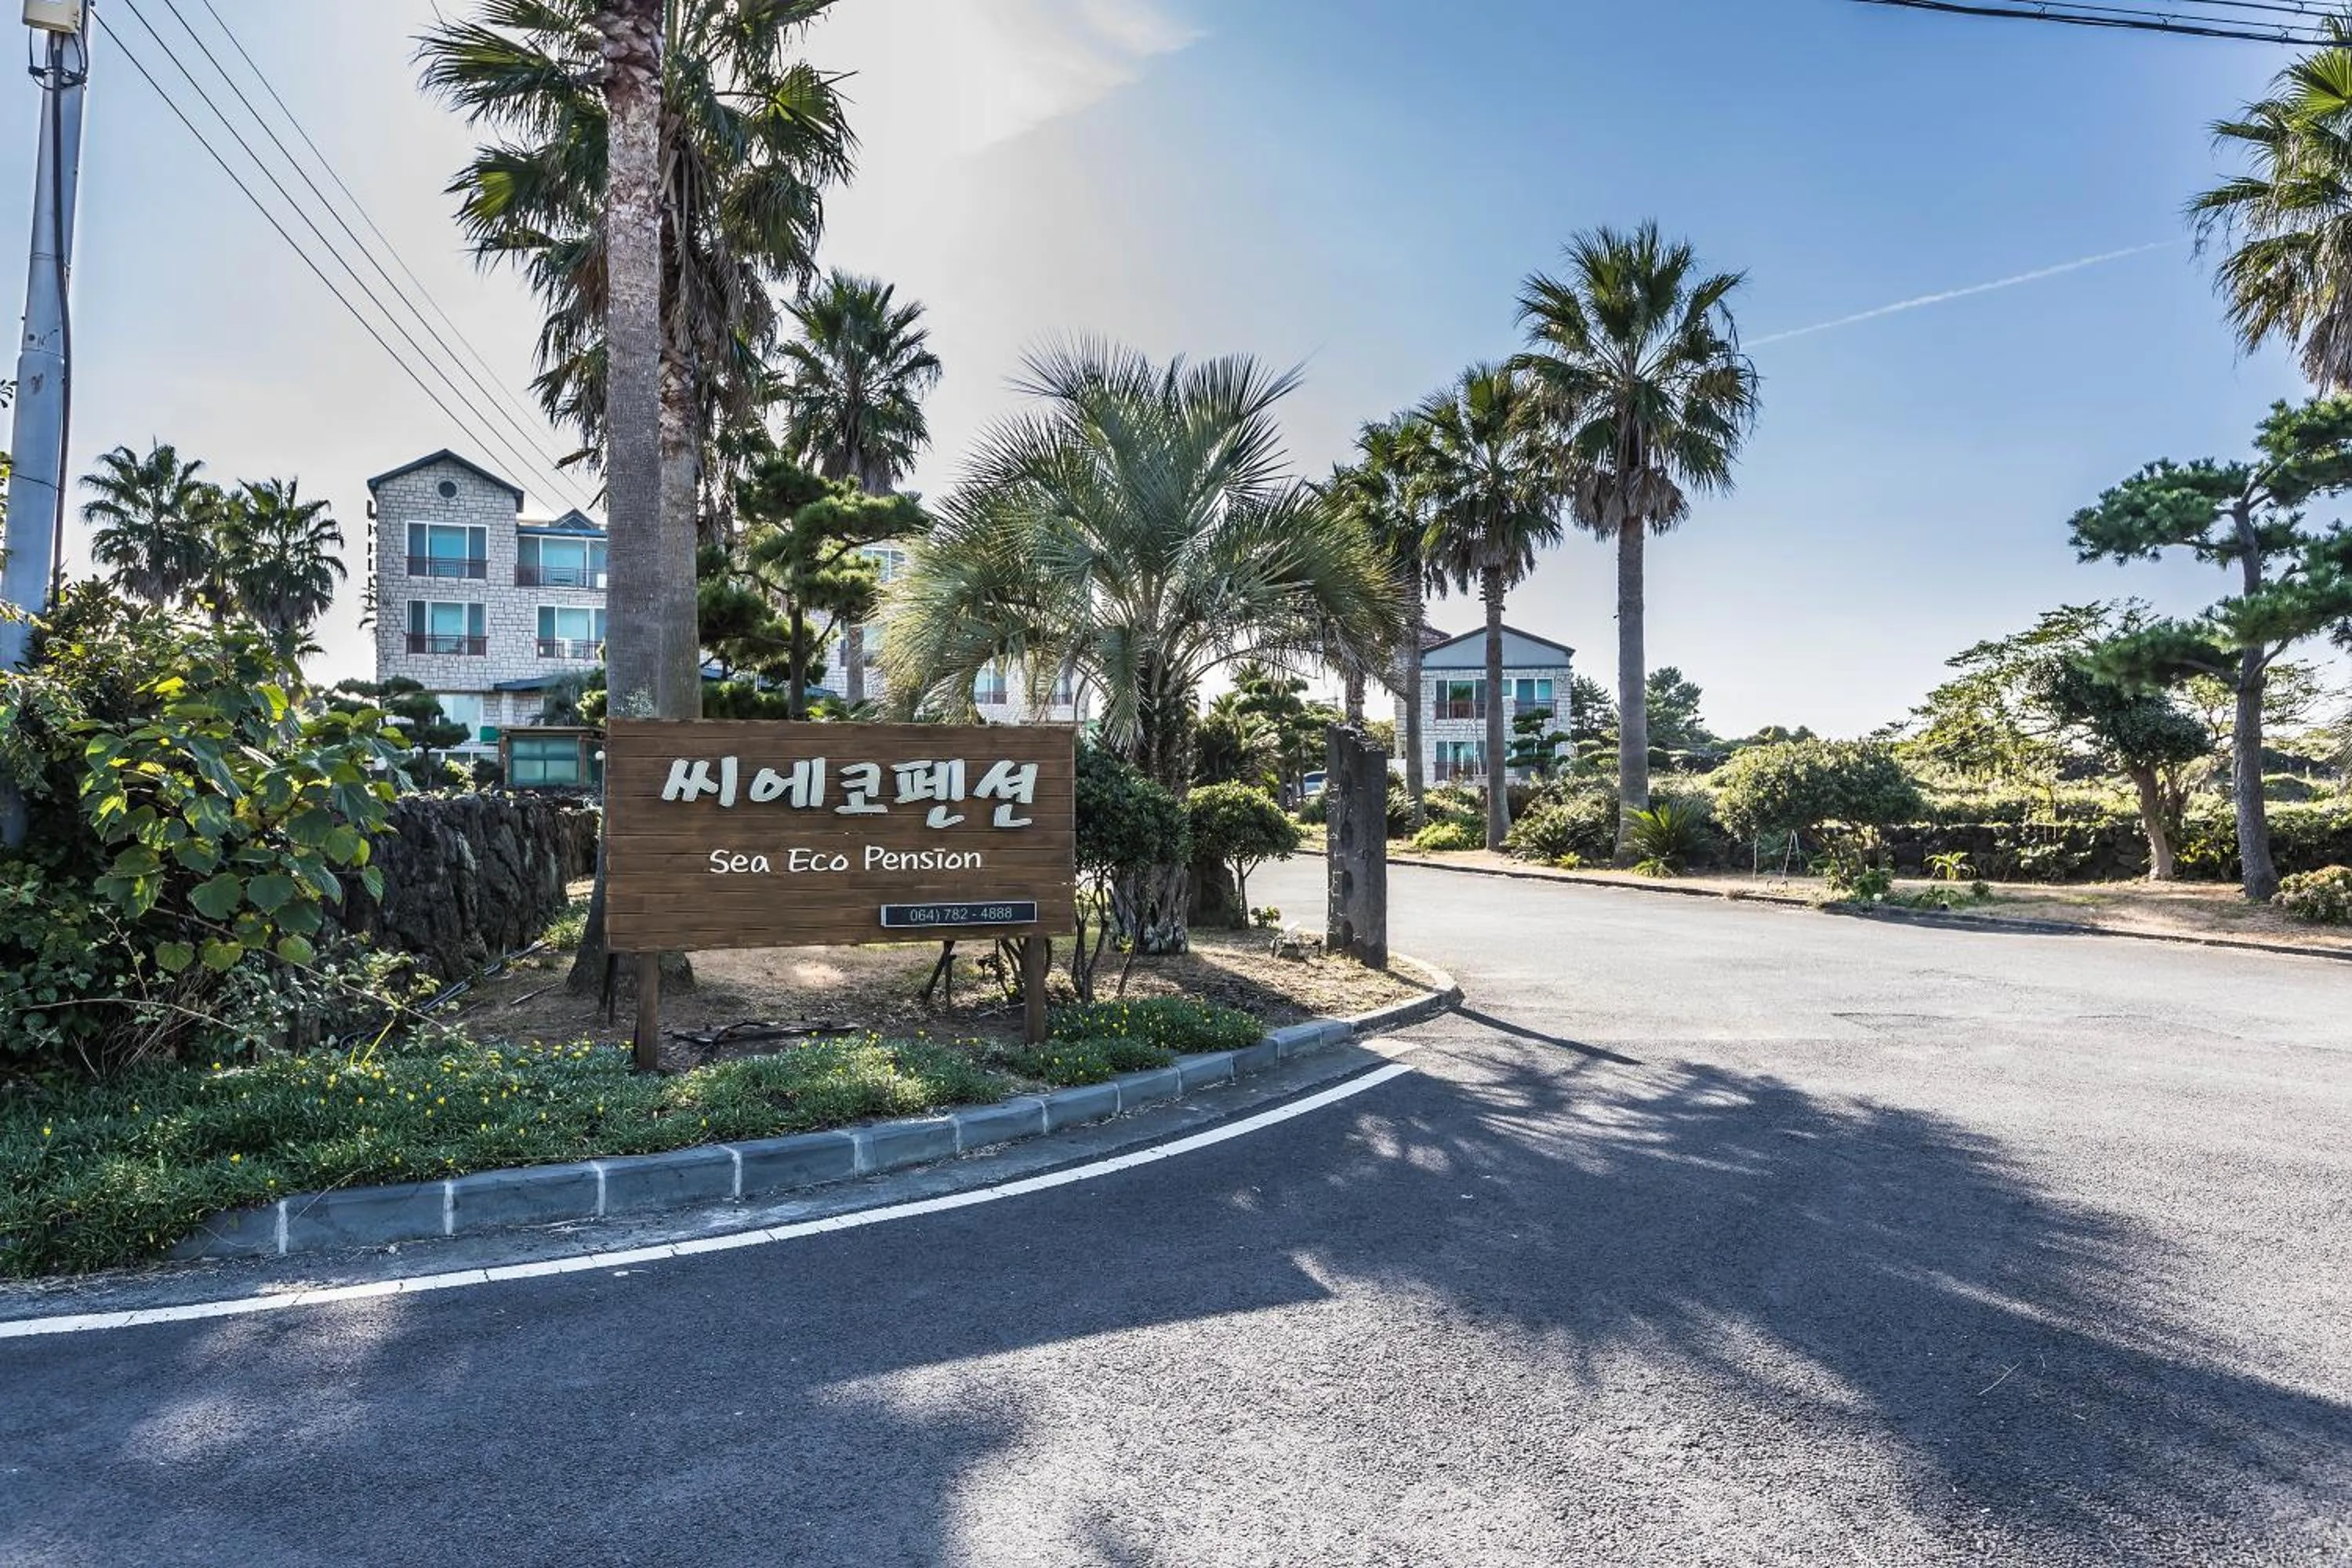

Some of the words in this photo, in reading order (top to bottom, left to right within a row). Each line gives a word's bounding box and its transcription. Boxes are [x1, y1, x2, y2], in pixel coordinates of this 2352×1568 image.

[661, 755, 1039, 829] 씨에코펜션
[710, 848, 771, 874] Sea
[787, 848, 849, 873] Eco
[865, 844, 982, 871] Pension
[981, 907, 1013, 920] 4888
